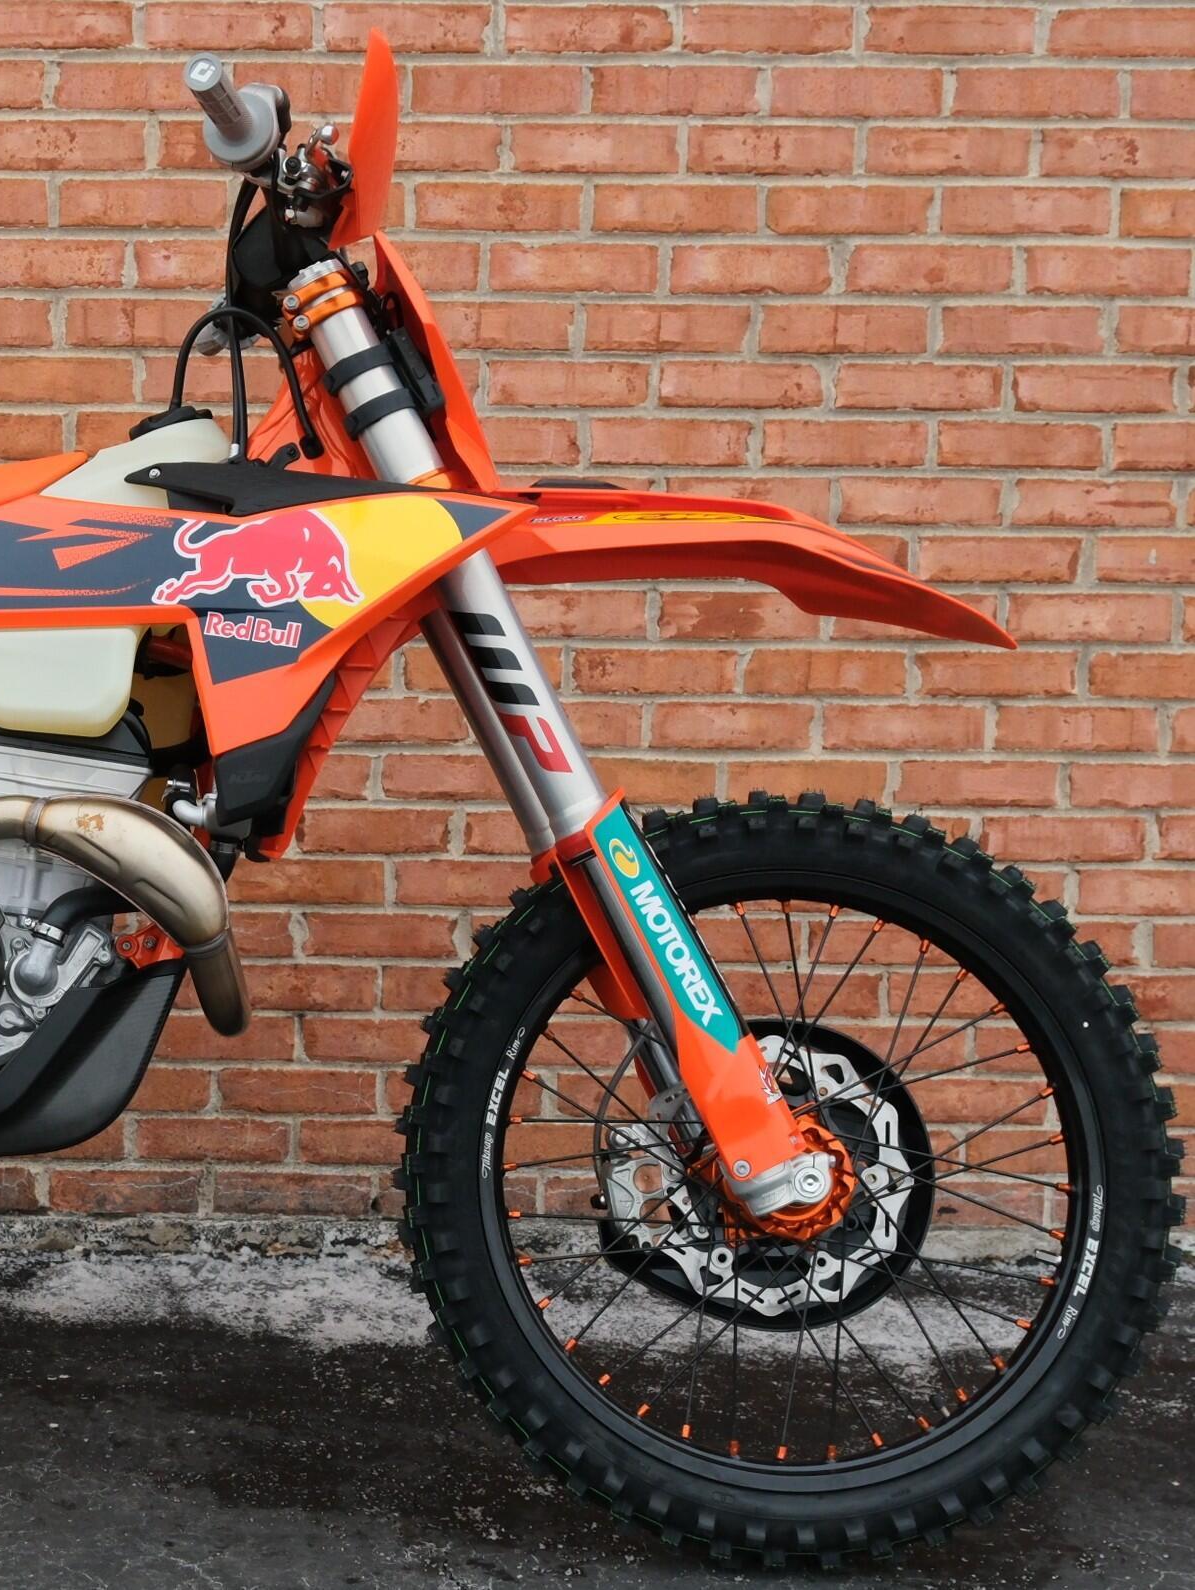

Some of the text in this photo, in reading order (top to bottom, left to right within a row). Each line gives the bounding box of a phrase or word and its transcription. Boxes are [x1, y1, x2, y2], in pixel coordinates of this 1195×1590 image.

[204, 611, 302, 649] Red Bull
[629, 879, 724, 1027] MOTOREX
[485, 1067, 510, 1127] EXCEL
[506, 1026, 525, 1061] Rim
[1072, 1237, 1100, 1297] EXCEL
[1057, 1304, 1079, 1341] Rim
